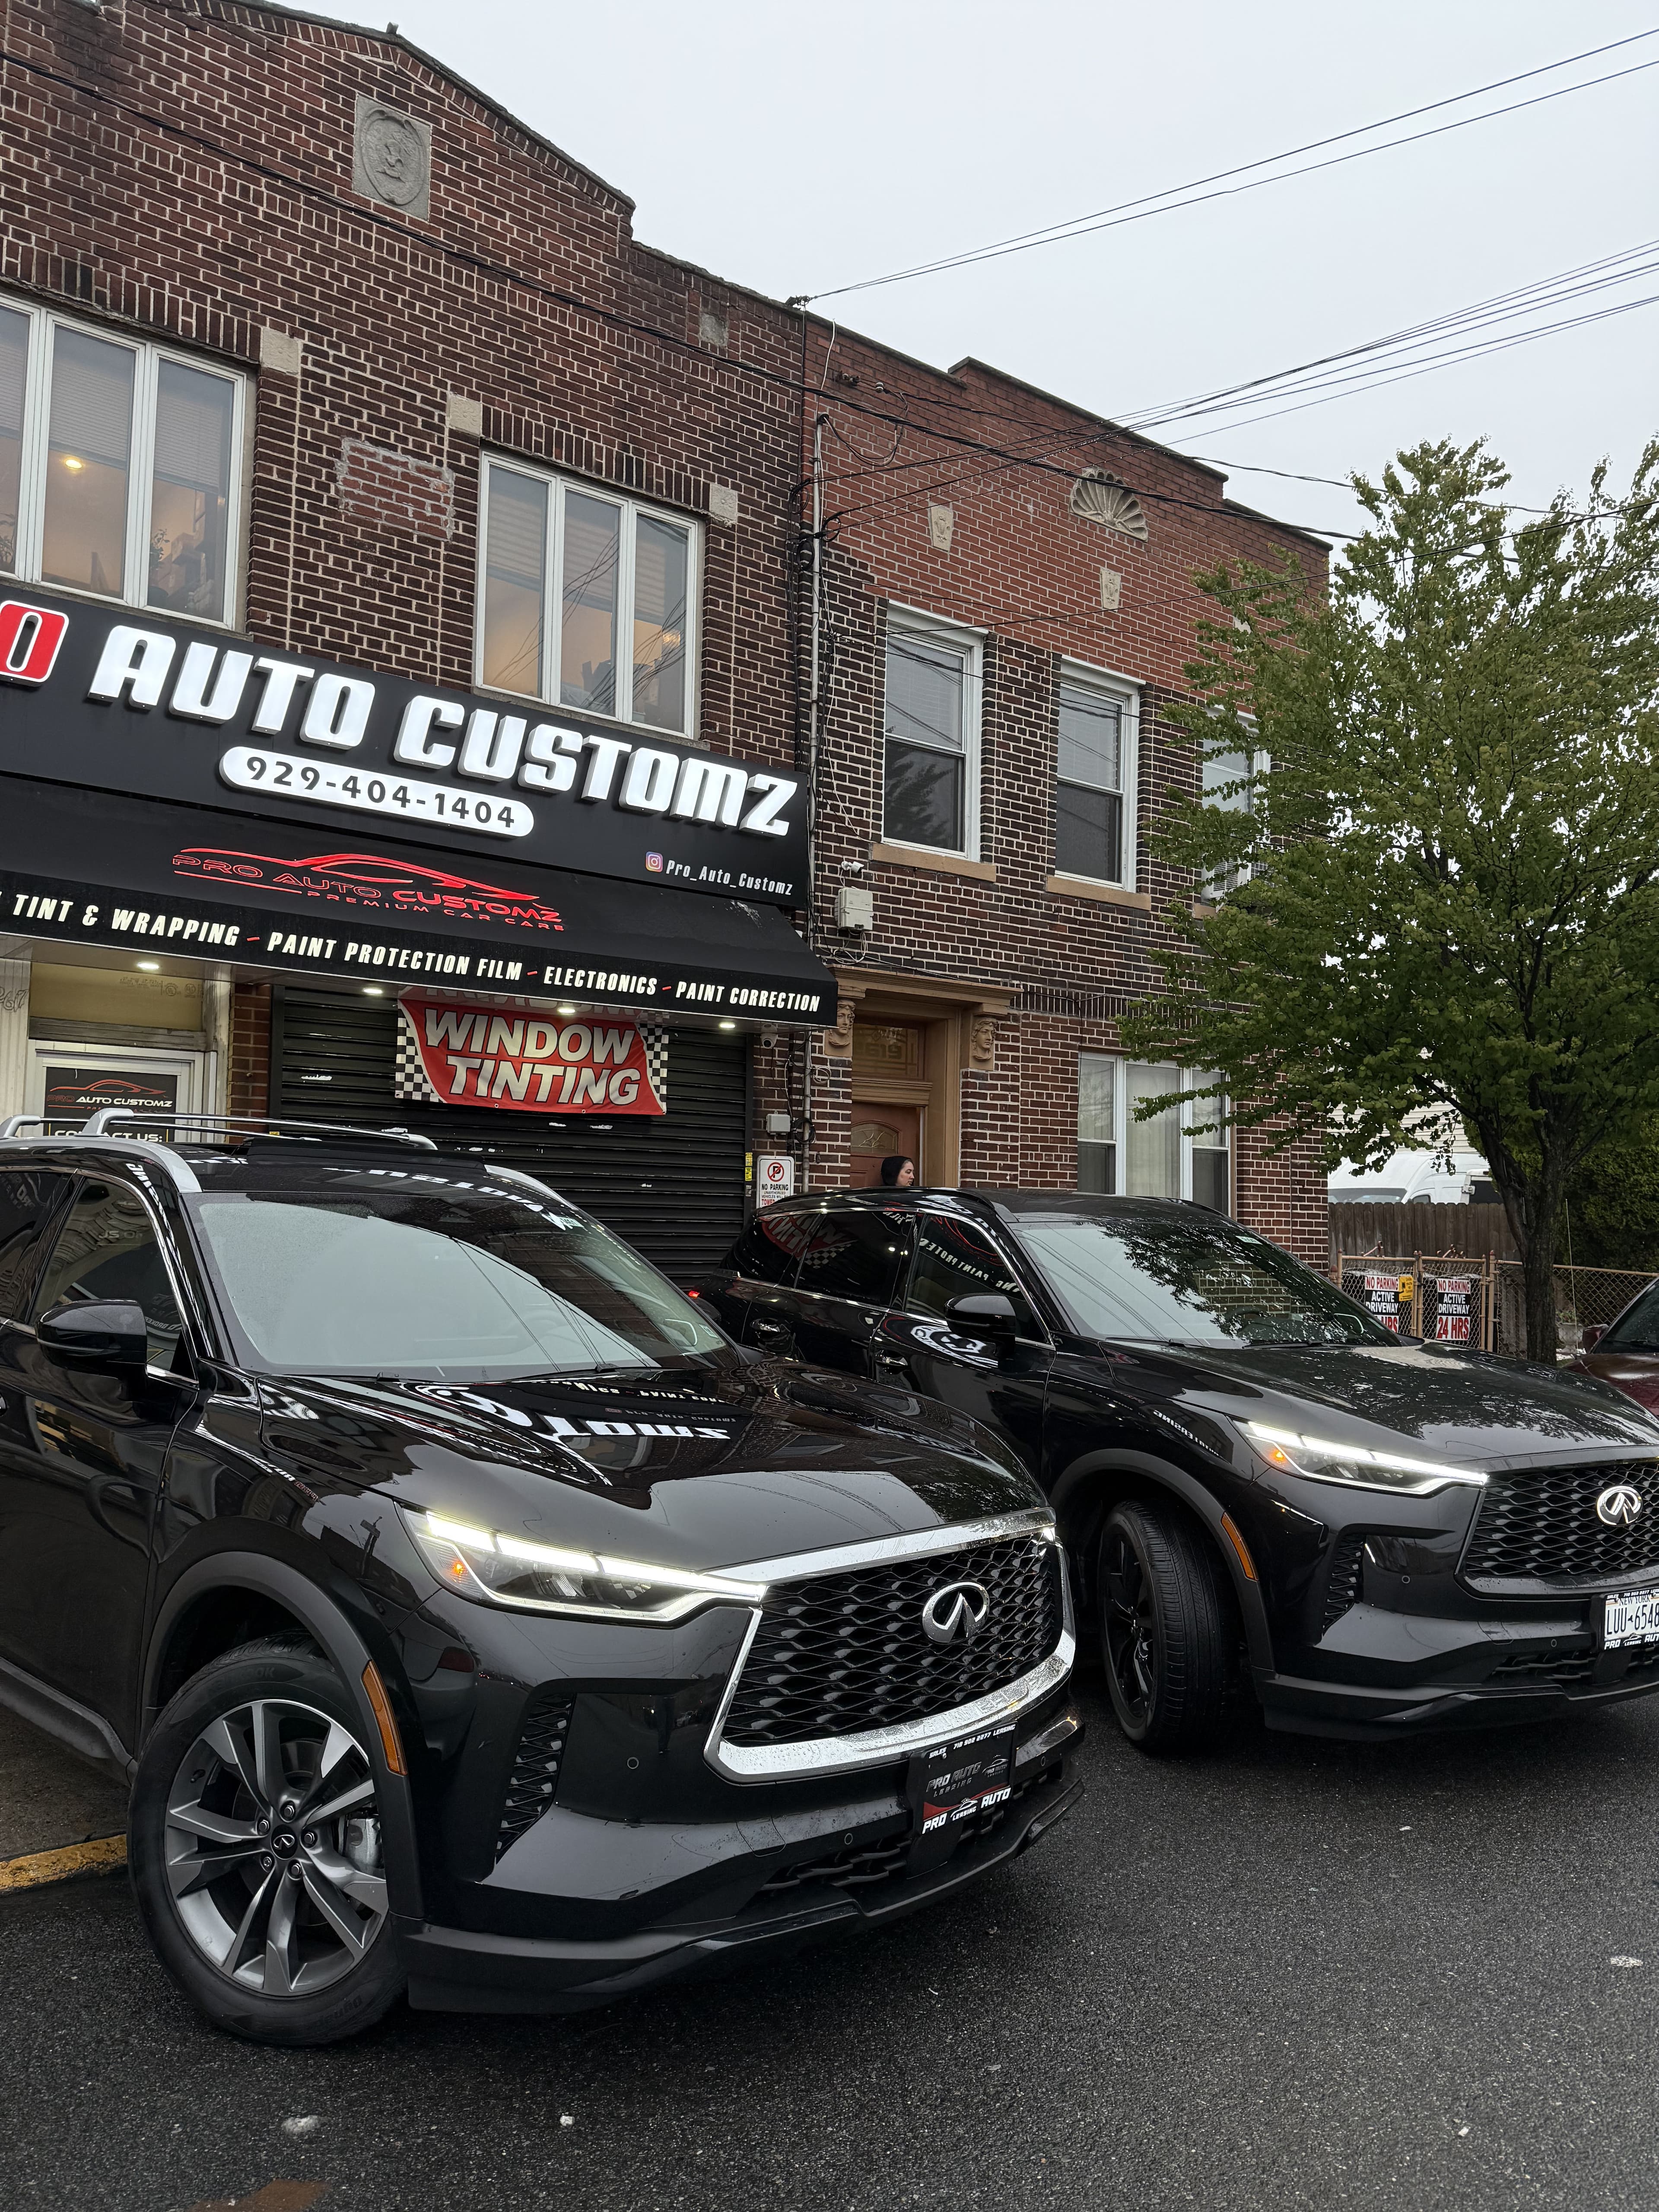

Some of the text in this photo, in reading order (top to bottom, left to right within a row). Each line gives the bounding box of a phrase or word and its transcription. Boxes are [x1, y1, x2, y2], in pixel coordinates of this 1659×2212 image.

[87, 625, 375, 750] AUTO
[394, 695, 798, 836] CUSTOMZ
[246, 756, 515, 828] 929-404-1404
[173, 854, 562, 922] PRO AUTO CUSTOMZ
[666, 860, 793, 896] Pro_Auto_Customz
[307, 891, 564, 931] PREMIUM CAR CARE
[13, 894, 73, 922] TINT
[82, 905, 99, 926] &
[111, 909, 240, 946] WRAPPING
[267, 932, 337, 959] PAINT
[344, 943, 469, 975] PROTECTION
[477, 958, 522, 981] FILM
[543, 966, 658, 995] ELECTRONICS
[675, 980, 725, 1004] PAINT
[729, 988, 820, 1012] CORRECTION
[425, 1008, 637, 1065] WINDOW
[446, 1054, 644, 1106] TINTING
[113, 1098, 173, 1107] CUSTOMZ
[1366, 1276, 1375, 1289] NO
[1376, 1277, 1398, 1290] PARKING
[1371, 1290, 1395, 1302] ACTIVE
[1438, 1280, 1470, 1293] NO PARKING
[1438, 1303, 1470, 1314] DRIVEWAY
[1443, 1294, 1465, 1304] ACTIVE
[1437, 1317, 1469, 1340] 24 HRS
[1619, 1594, 1650, 1605] NEW YORK
[1607, 1603, 1659, 1635] LUU 6548
[1604, 1639, 1621, 1650] PRO
[1644, 1634, 1659, 1643] AUT
[929, 1747, 947, 1759] SALES
[976, 1732, 992, 1742] 2277
[993, 1724, 1016, 1736] LEASING
[926, 1761, 982, 1792] PRO AUTO
[934, 1778, 972, 1797] LEASING
[922, 1788, 1011, 1834] PRO LEASING AUTO
